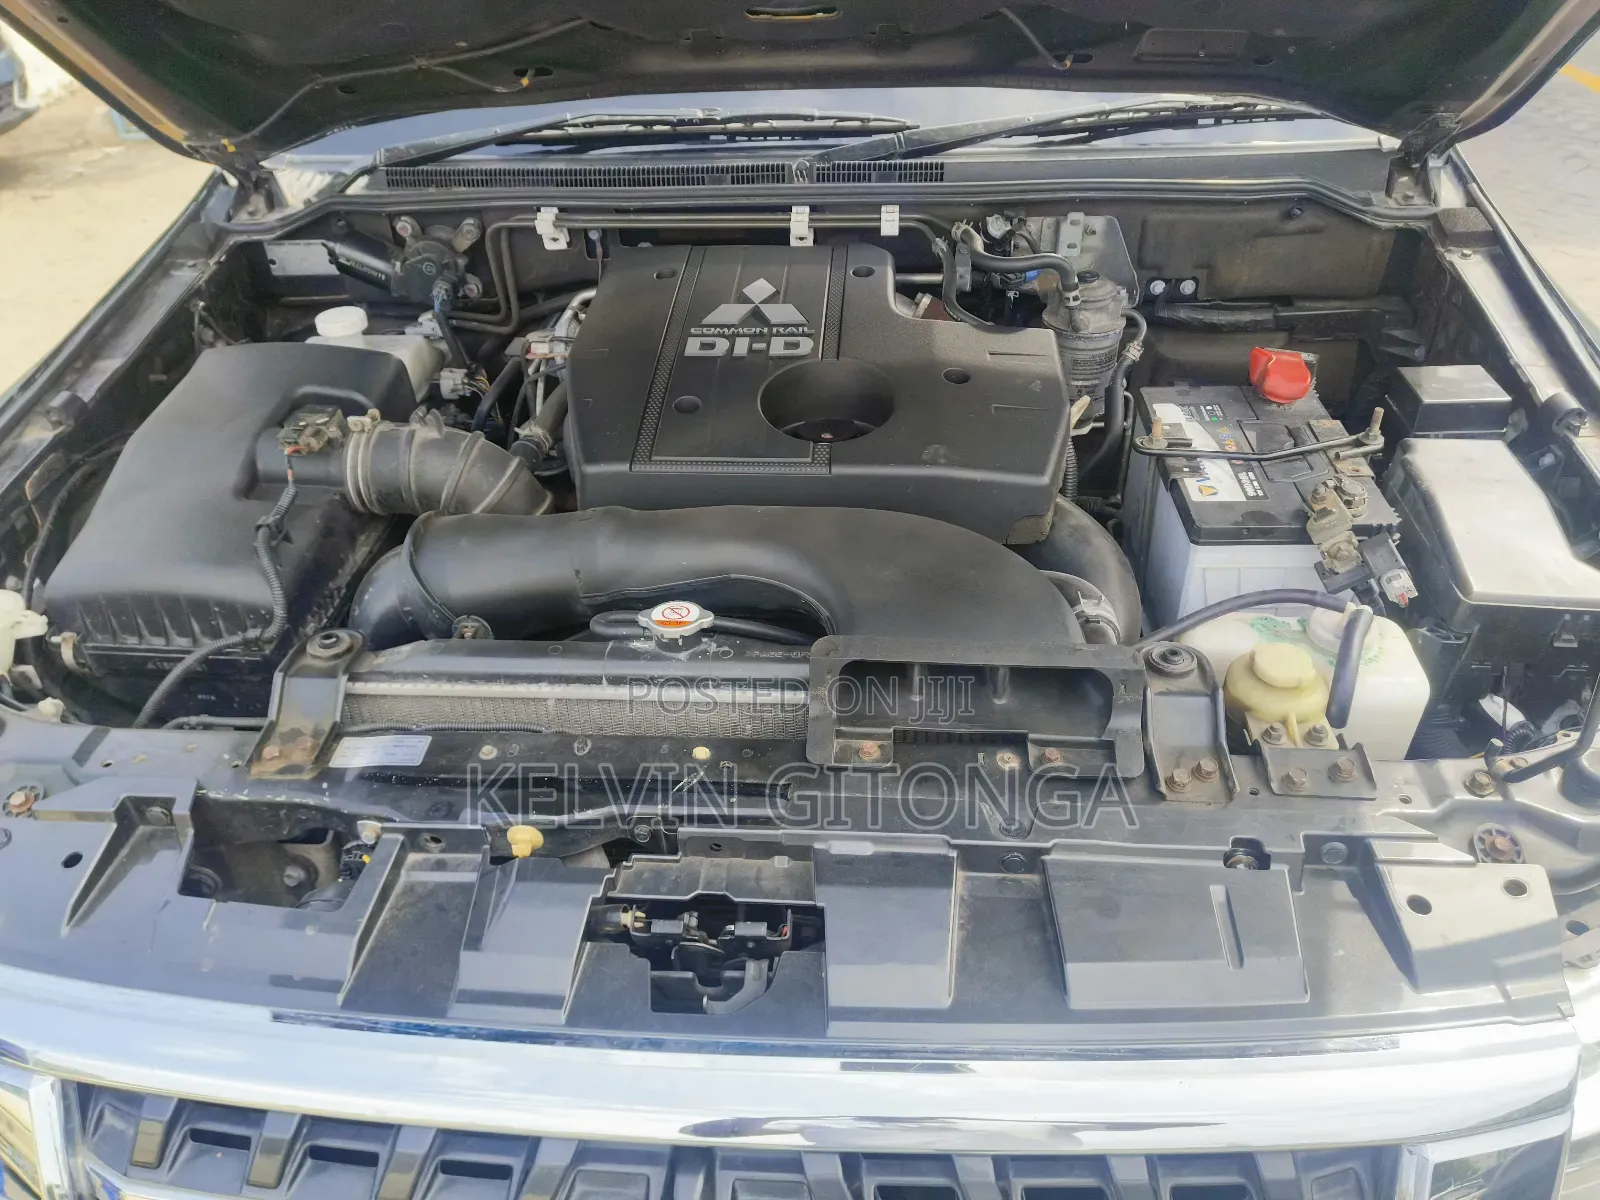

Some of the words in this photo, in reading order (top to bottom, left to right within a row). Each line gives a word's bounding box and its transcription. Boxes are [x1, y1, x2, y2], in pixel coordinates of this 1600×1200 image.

[690, 327, 768, 336] COMMON
[772, 326, 816, 335] RAIL
[684, 336, 814, 357] DI-D
